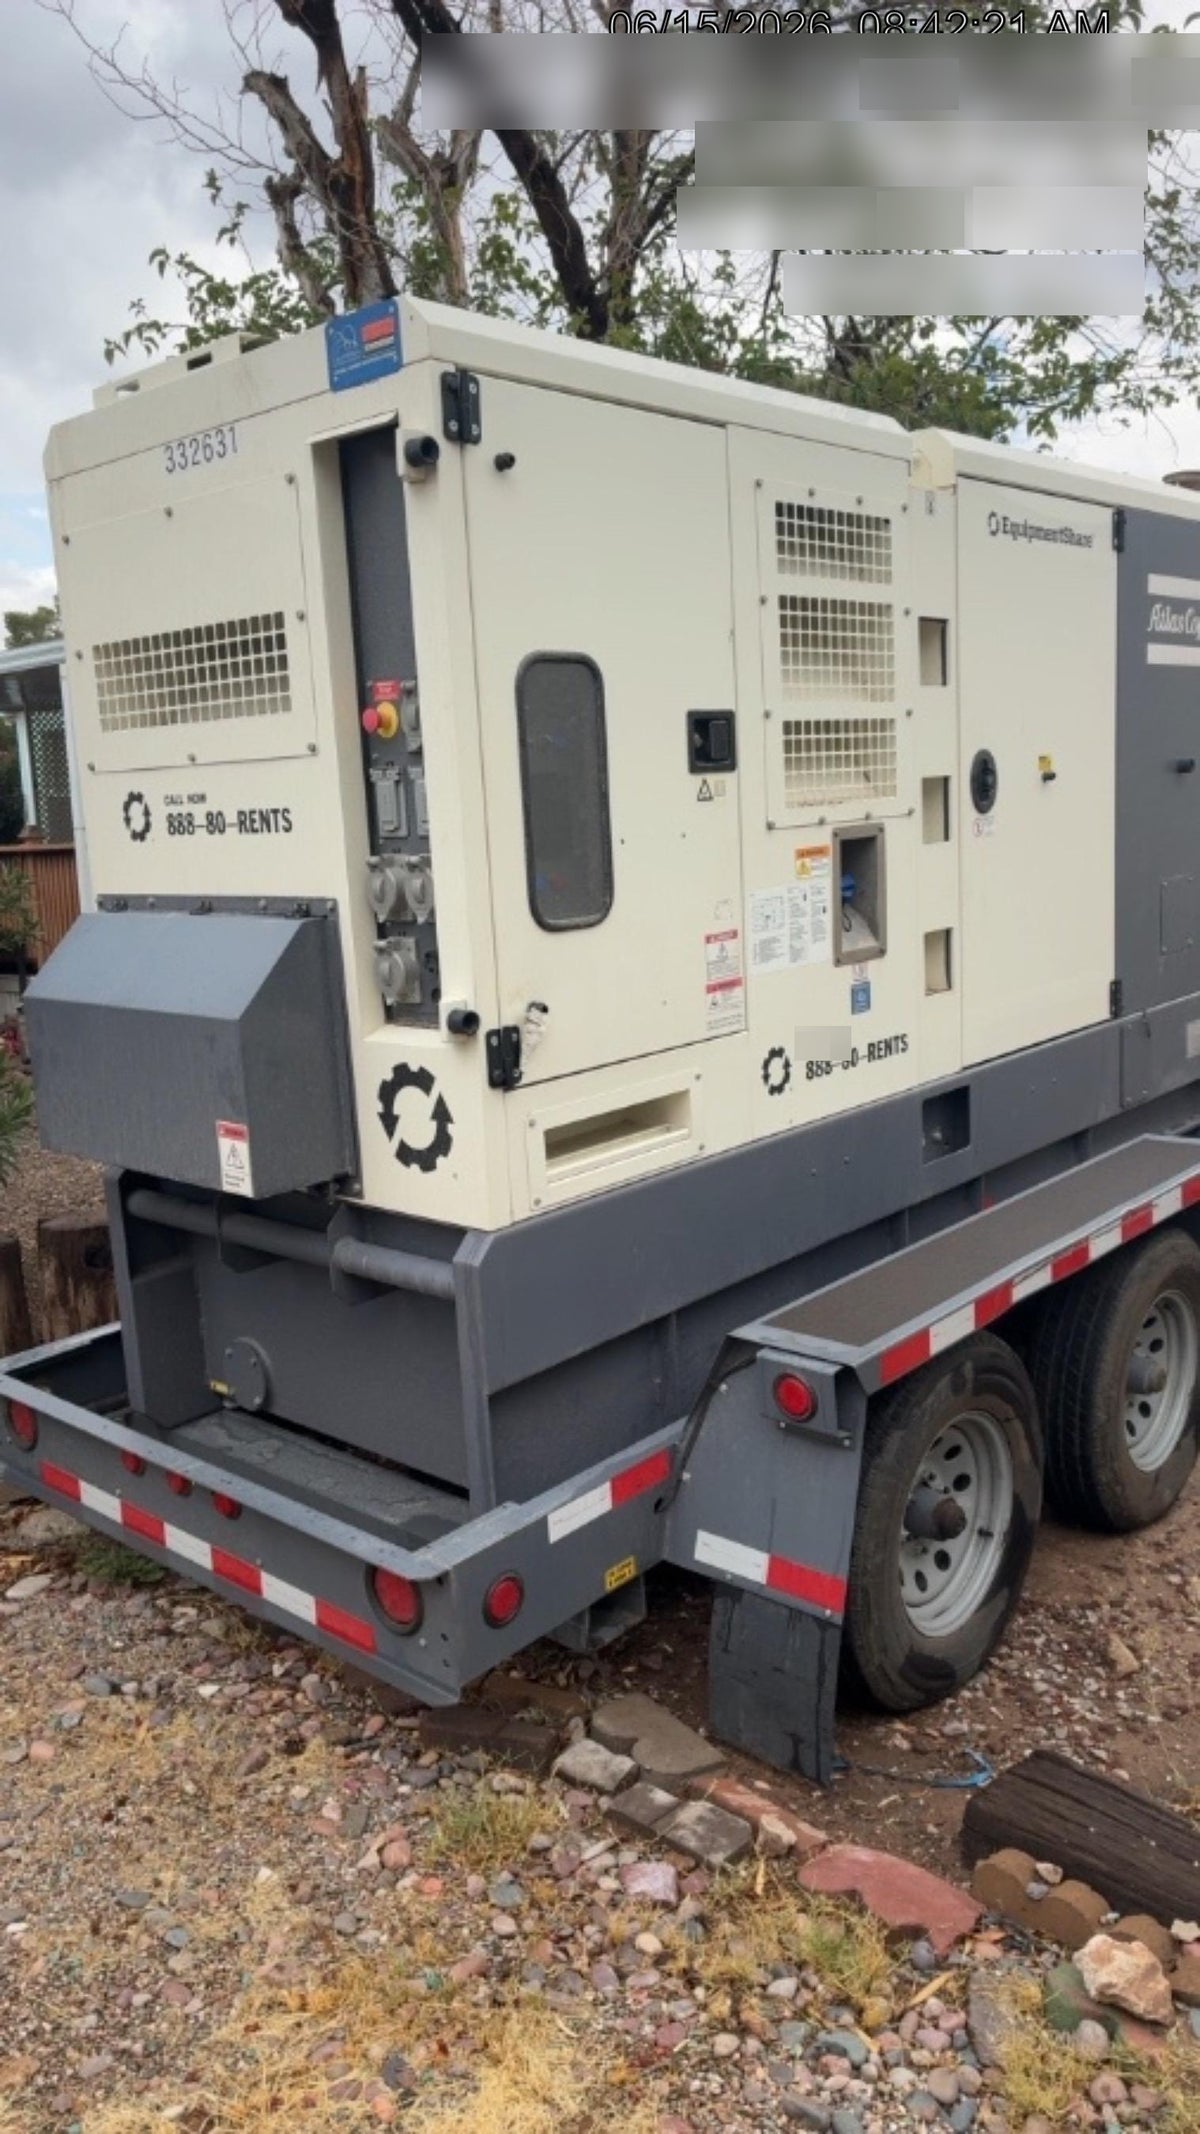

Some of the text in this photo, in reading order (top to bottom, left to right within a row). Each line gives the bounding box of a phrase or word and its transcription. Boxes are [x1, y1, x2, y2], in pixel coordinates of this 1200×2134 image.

[164, 426, 238, 473] 332631
[1002, 516, 1092, 548] EquipmentShare
[1146, 603, 1184, 634] Atlas
[163, 793, 207, 806] CALL NOW
[166, 808, 293, 835] 888-80-RENTS
